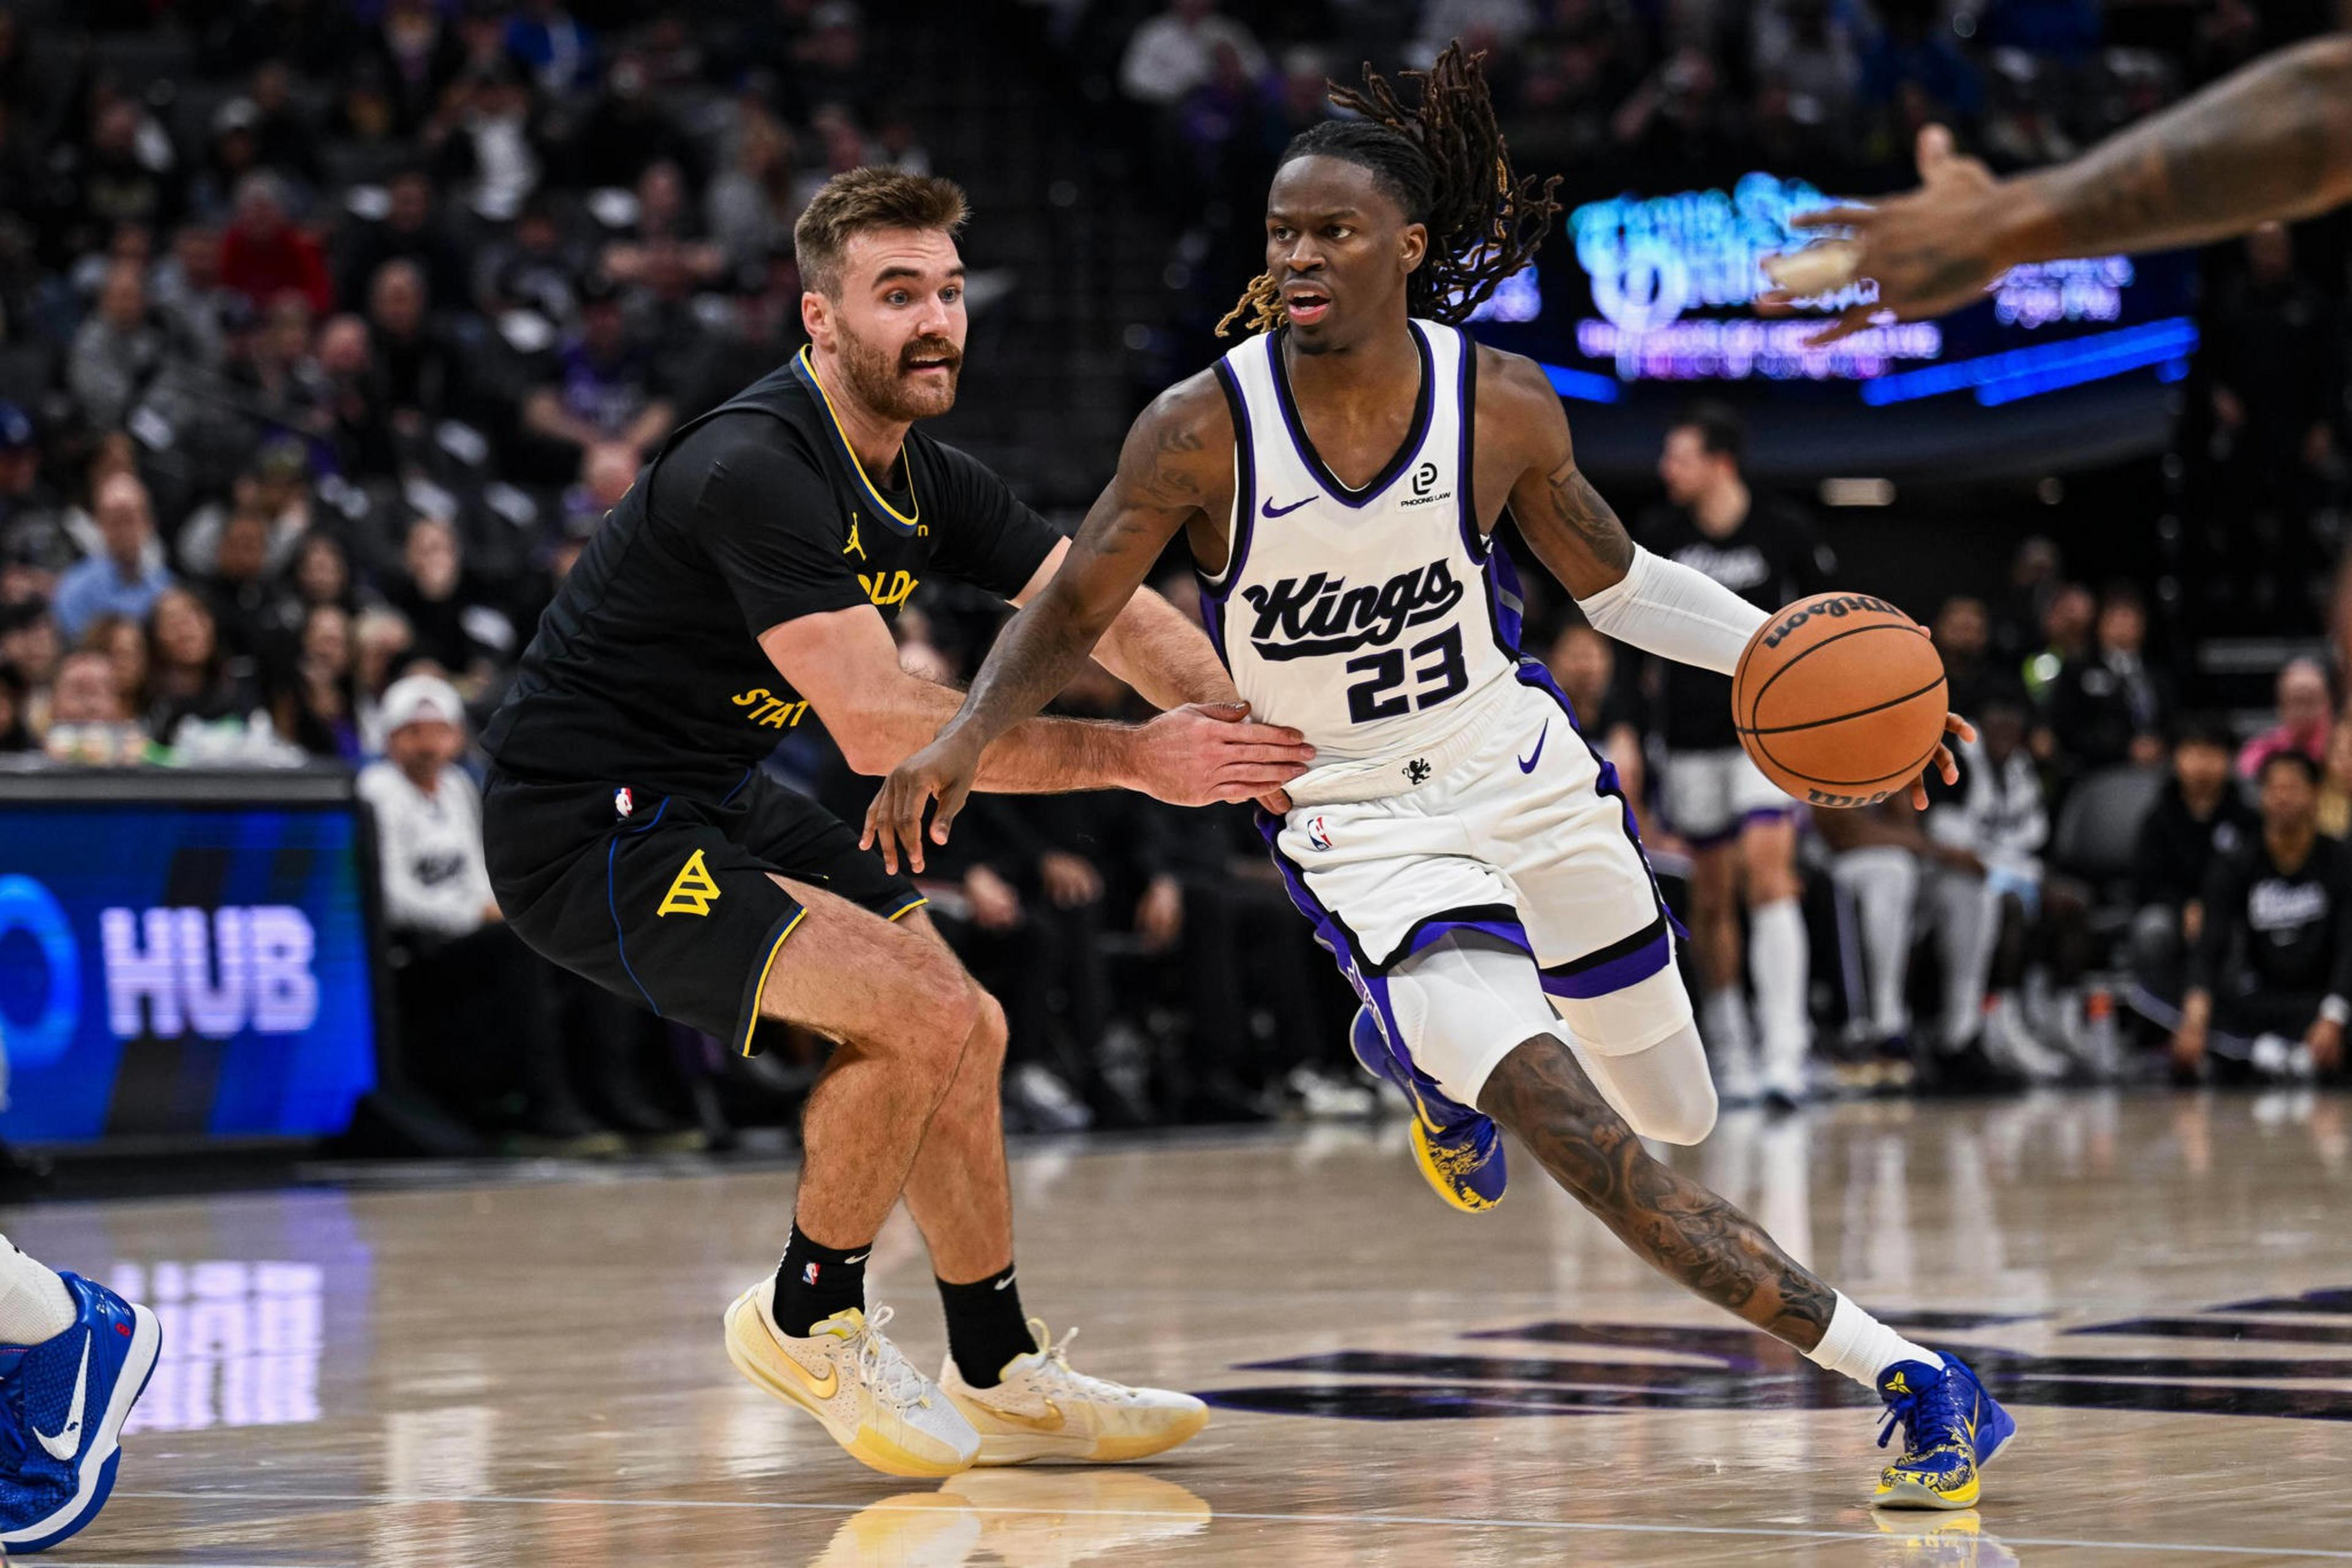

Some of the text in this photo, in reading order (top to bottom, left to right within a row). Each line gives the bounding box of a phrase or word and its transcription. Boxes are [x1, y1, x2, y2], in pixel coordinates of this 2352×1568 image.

[1401, 492, 1451, 507] PHOONG LAW
[1242, 557, 1464, 662] Kings
[1763, 597, 1904, 649] Wilson
[1346, 622, 1469, 724] 23
[100, 903, 320, 1039] HUB
